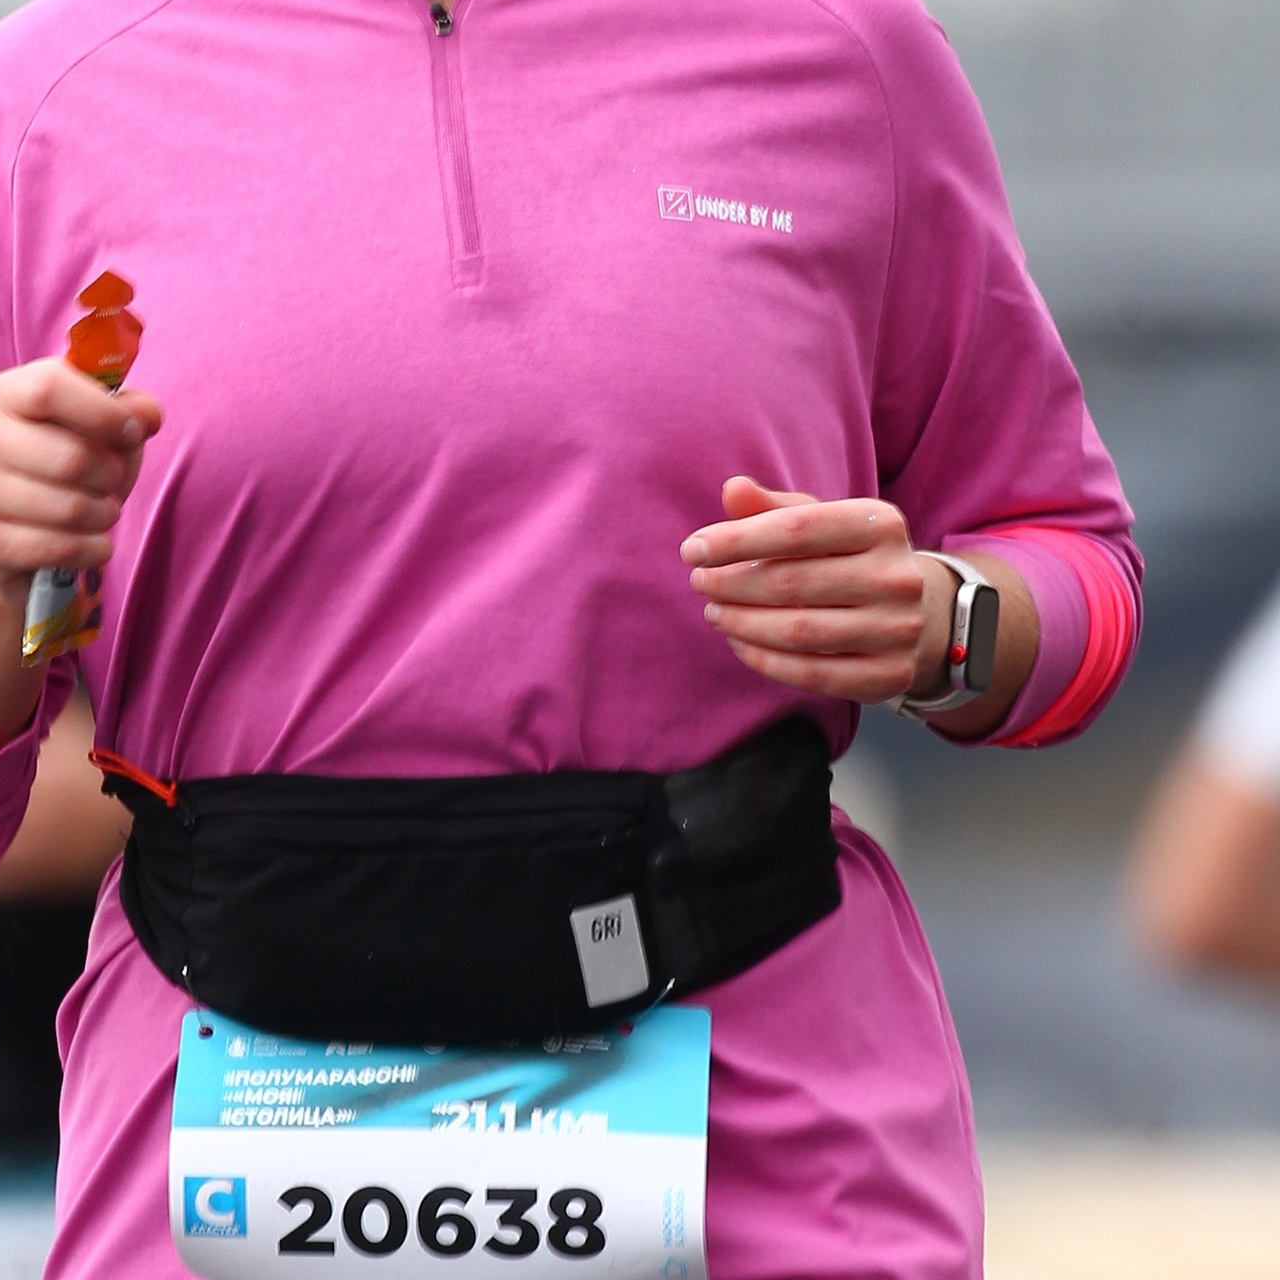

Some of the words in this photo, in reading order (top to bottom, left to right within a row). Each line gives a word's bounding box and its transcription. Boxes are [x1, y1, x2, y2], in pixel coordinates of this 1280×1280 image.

[695, 196, 747, 225] UNDER
[750, 205, 768, 227] BY
[771, 210, 793, 233] ME
[233, 1064, 409, 1087] ПОЛУМАРАФОН
[277, 1186, 607, 1260] 20638
